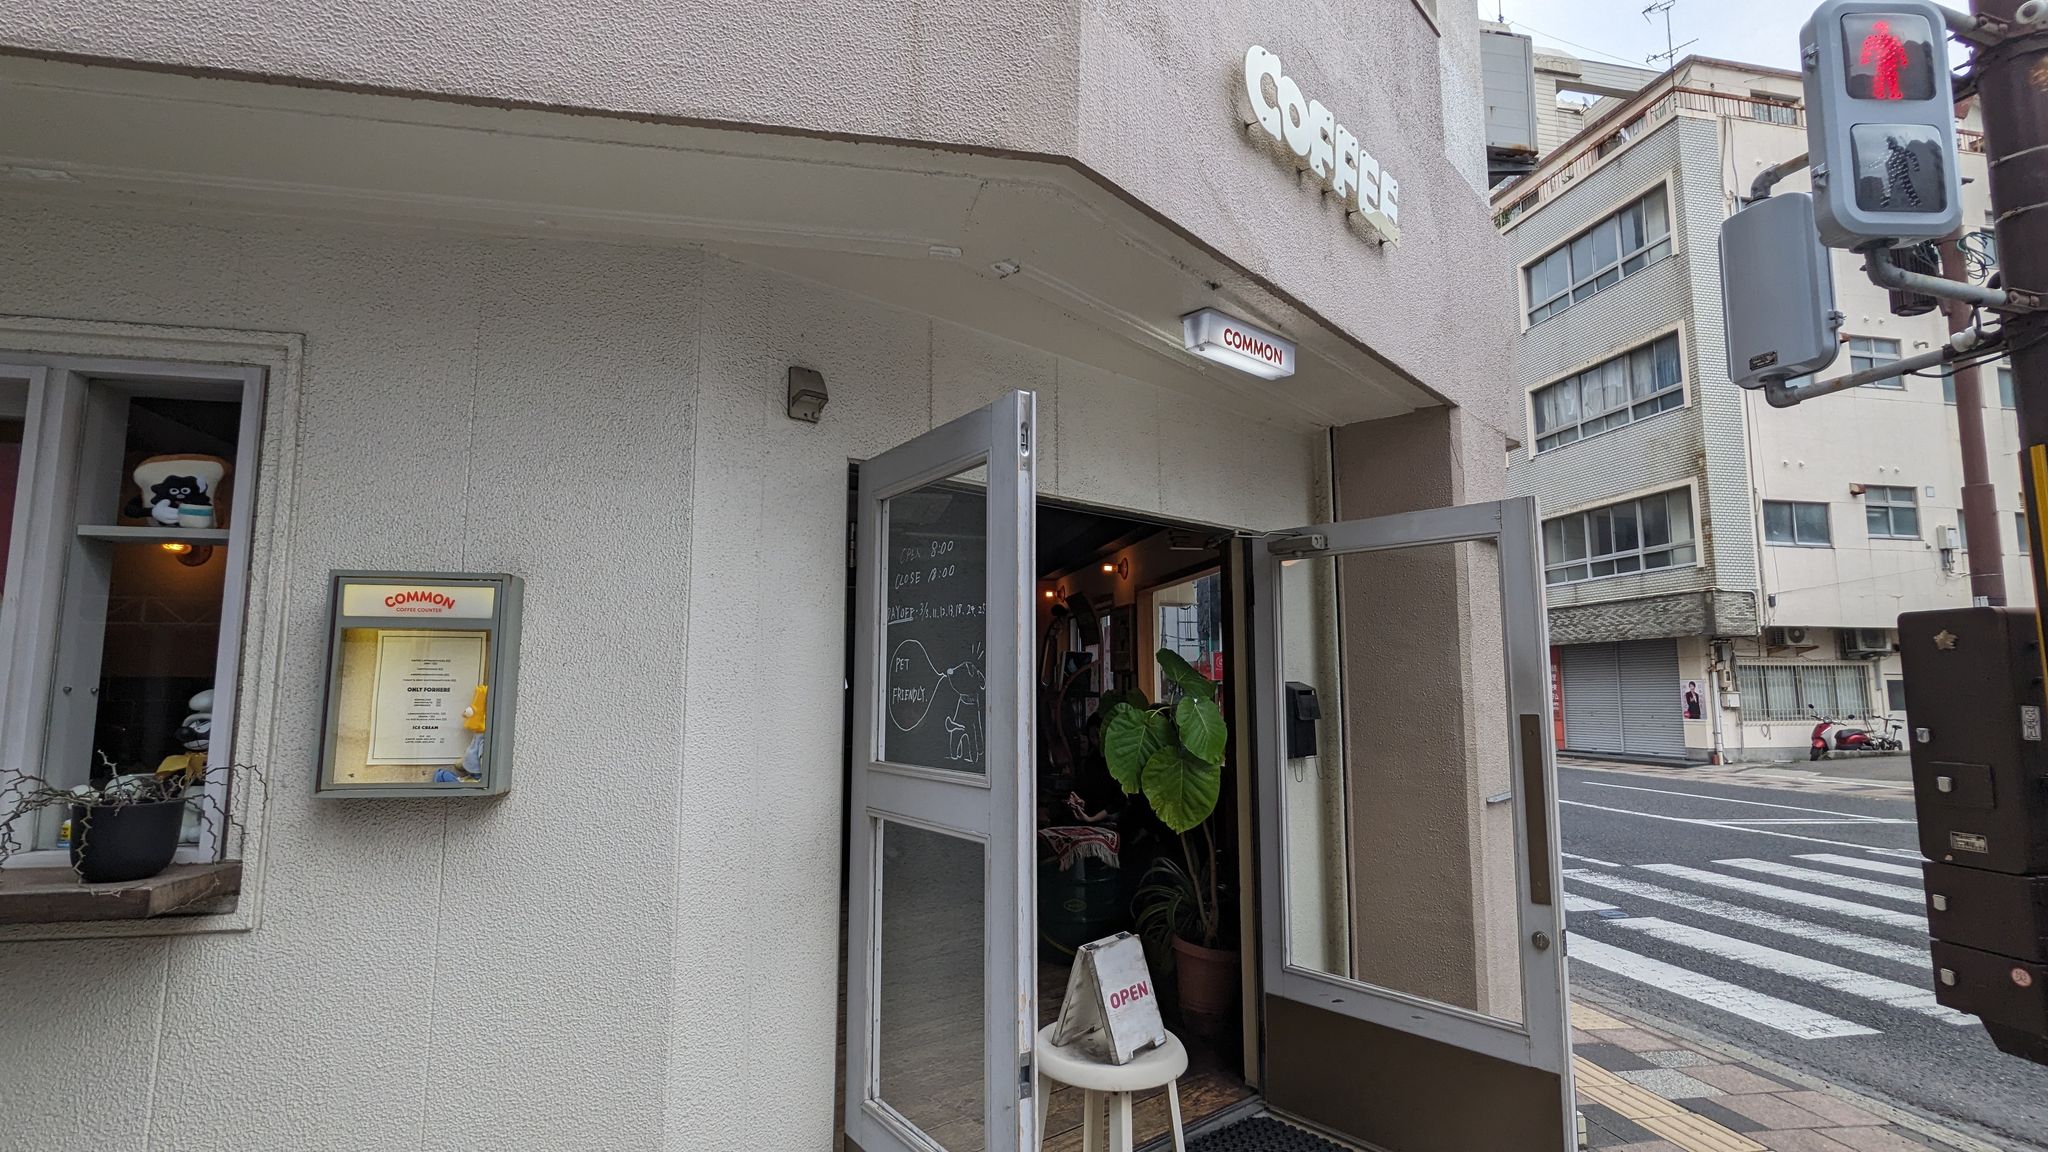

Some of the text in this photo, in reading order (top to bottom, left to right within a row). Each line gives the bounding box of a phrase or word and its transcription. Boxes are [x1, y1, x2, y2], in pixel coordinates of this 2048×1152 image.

[1245, 44, 1400, 250] COFFEE
[1224, 328, 1283, 365] COMMON
[931, 541, 953, 557] 8:00
[895, 572, 920, 589] CLOSE
[385, 591, 455, 609] COMMON
[896, 658, 910, 672] PET
[1110, 981, 1148, 1009] OPEN
